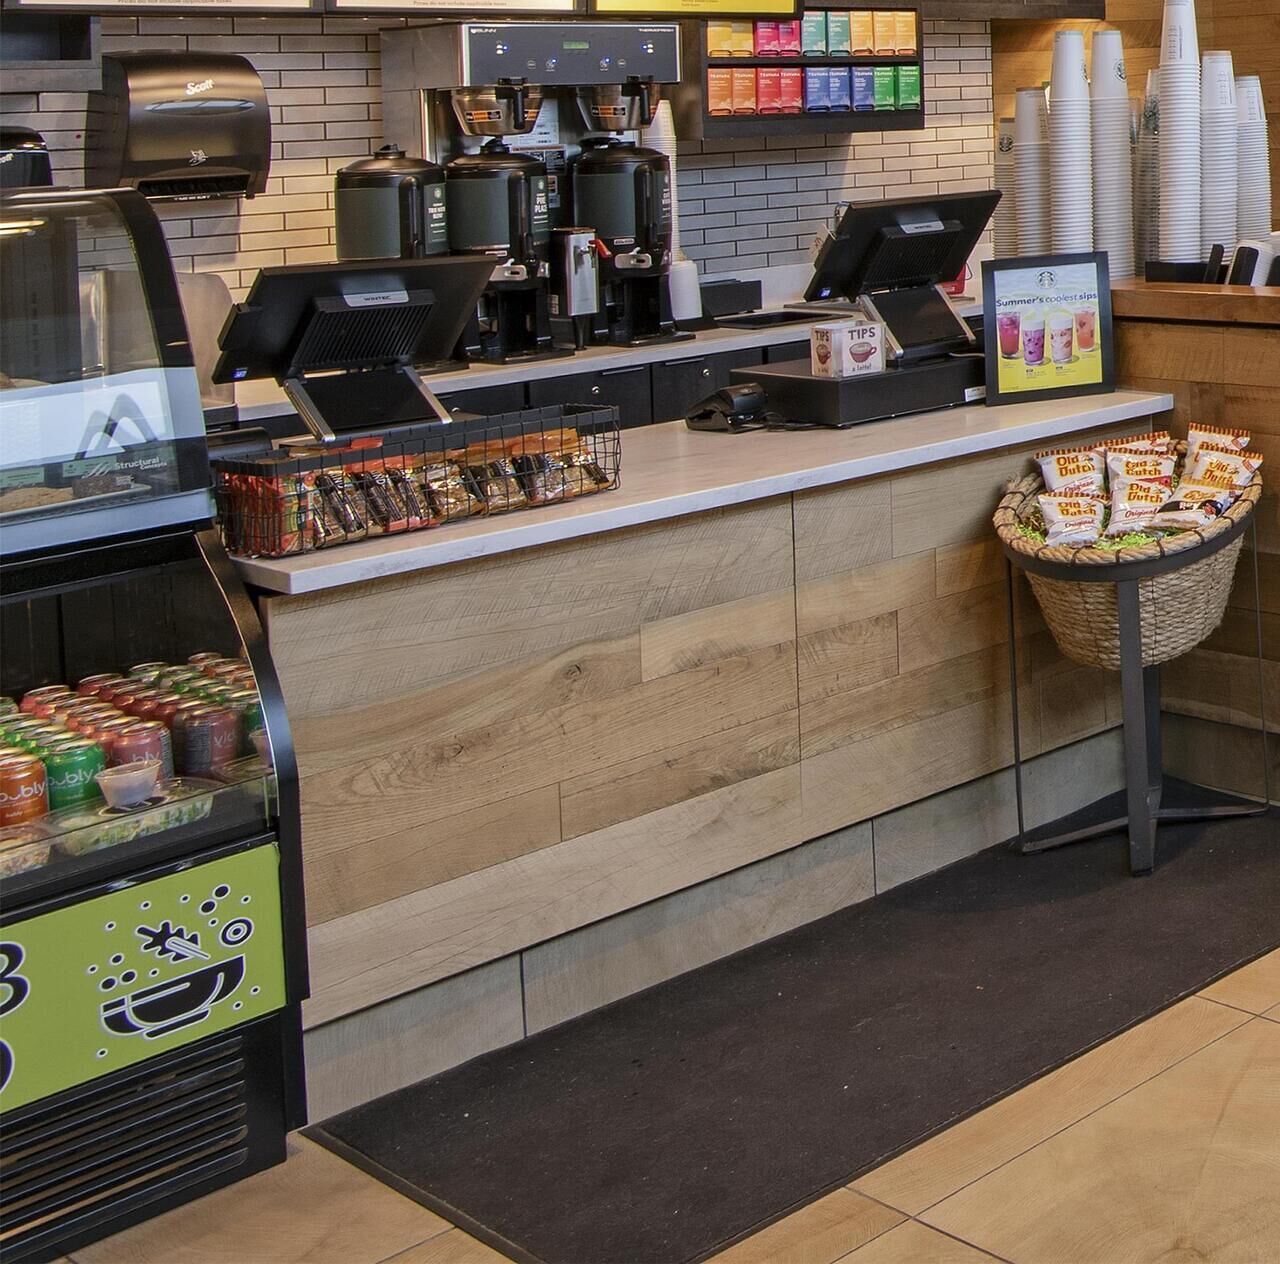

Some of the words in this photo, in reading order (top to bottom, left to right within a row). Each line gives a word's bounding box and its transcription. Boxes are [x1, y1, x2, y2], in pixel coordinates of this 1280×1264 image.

[186, 78, 215, 96] Scott
[996, 296, 1045, 308] Summer’s
[1046, 293, 1078, 304] coolest
[1079, 292, 1098, 302] sips
[814, 330, 830, 342] TIPS
[848, 326, 876, 340] TIPS
[114, 456, 160, 470] Structural
[1056, 456, 1079, 466] Old
[1059, 463, 1096, 476] Dutch
[1130, 483, 1151, 493] Old
[1128, 492, 1163, 504] Dutch
[1060, 507, 1096, 516] Dutch
